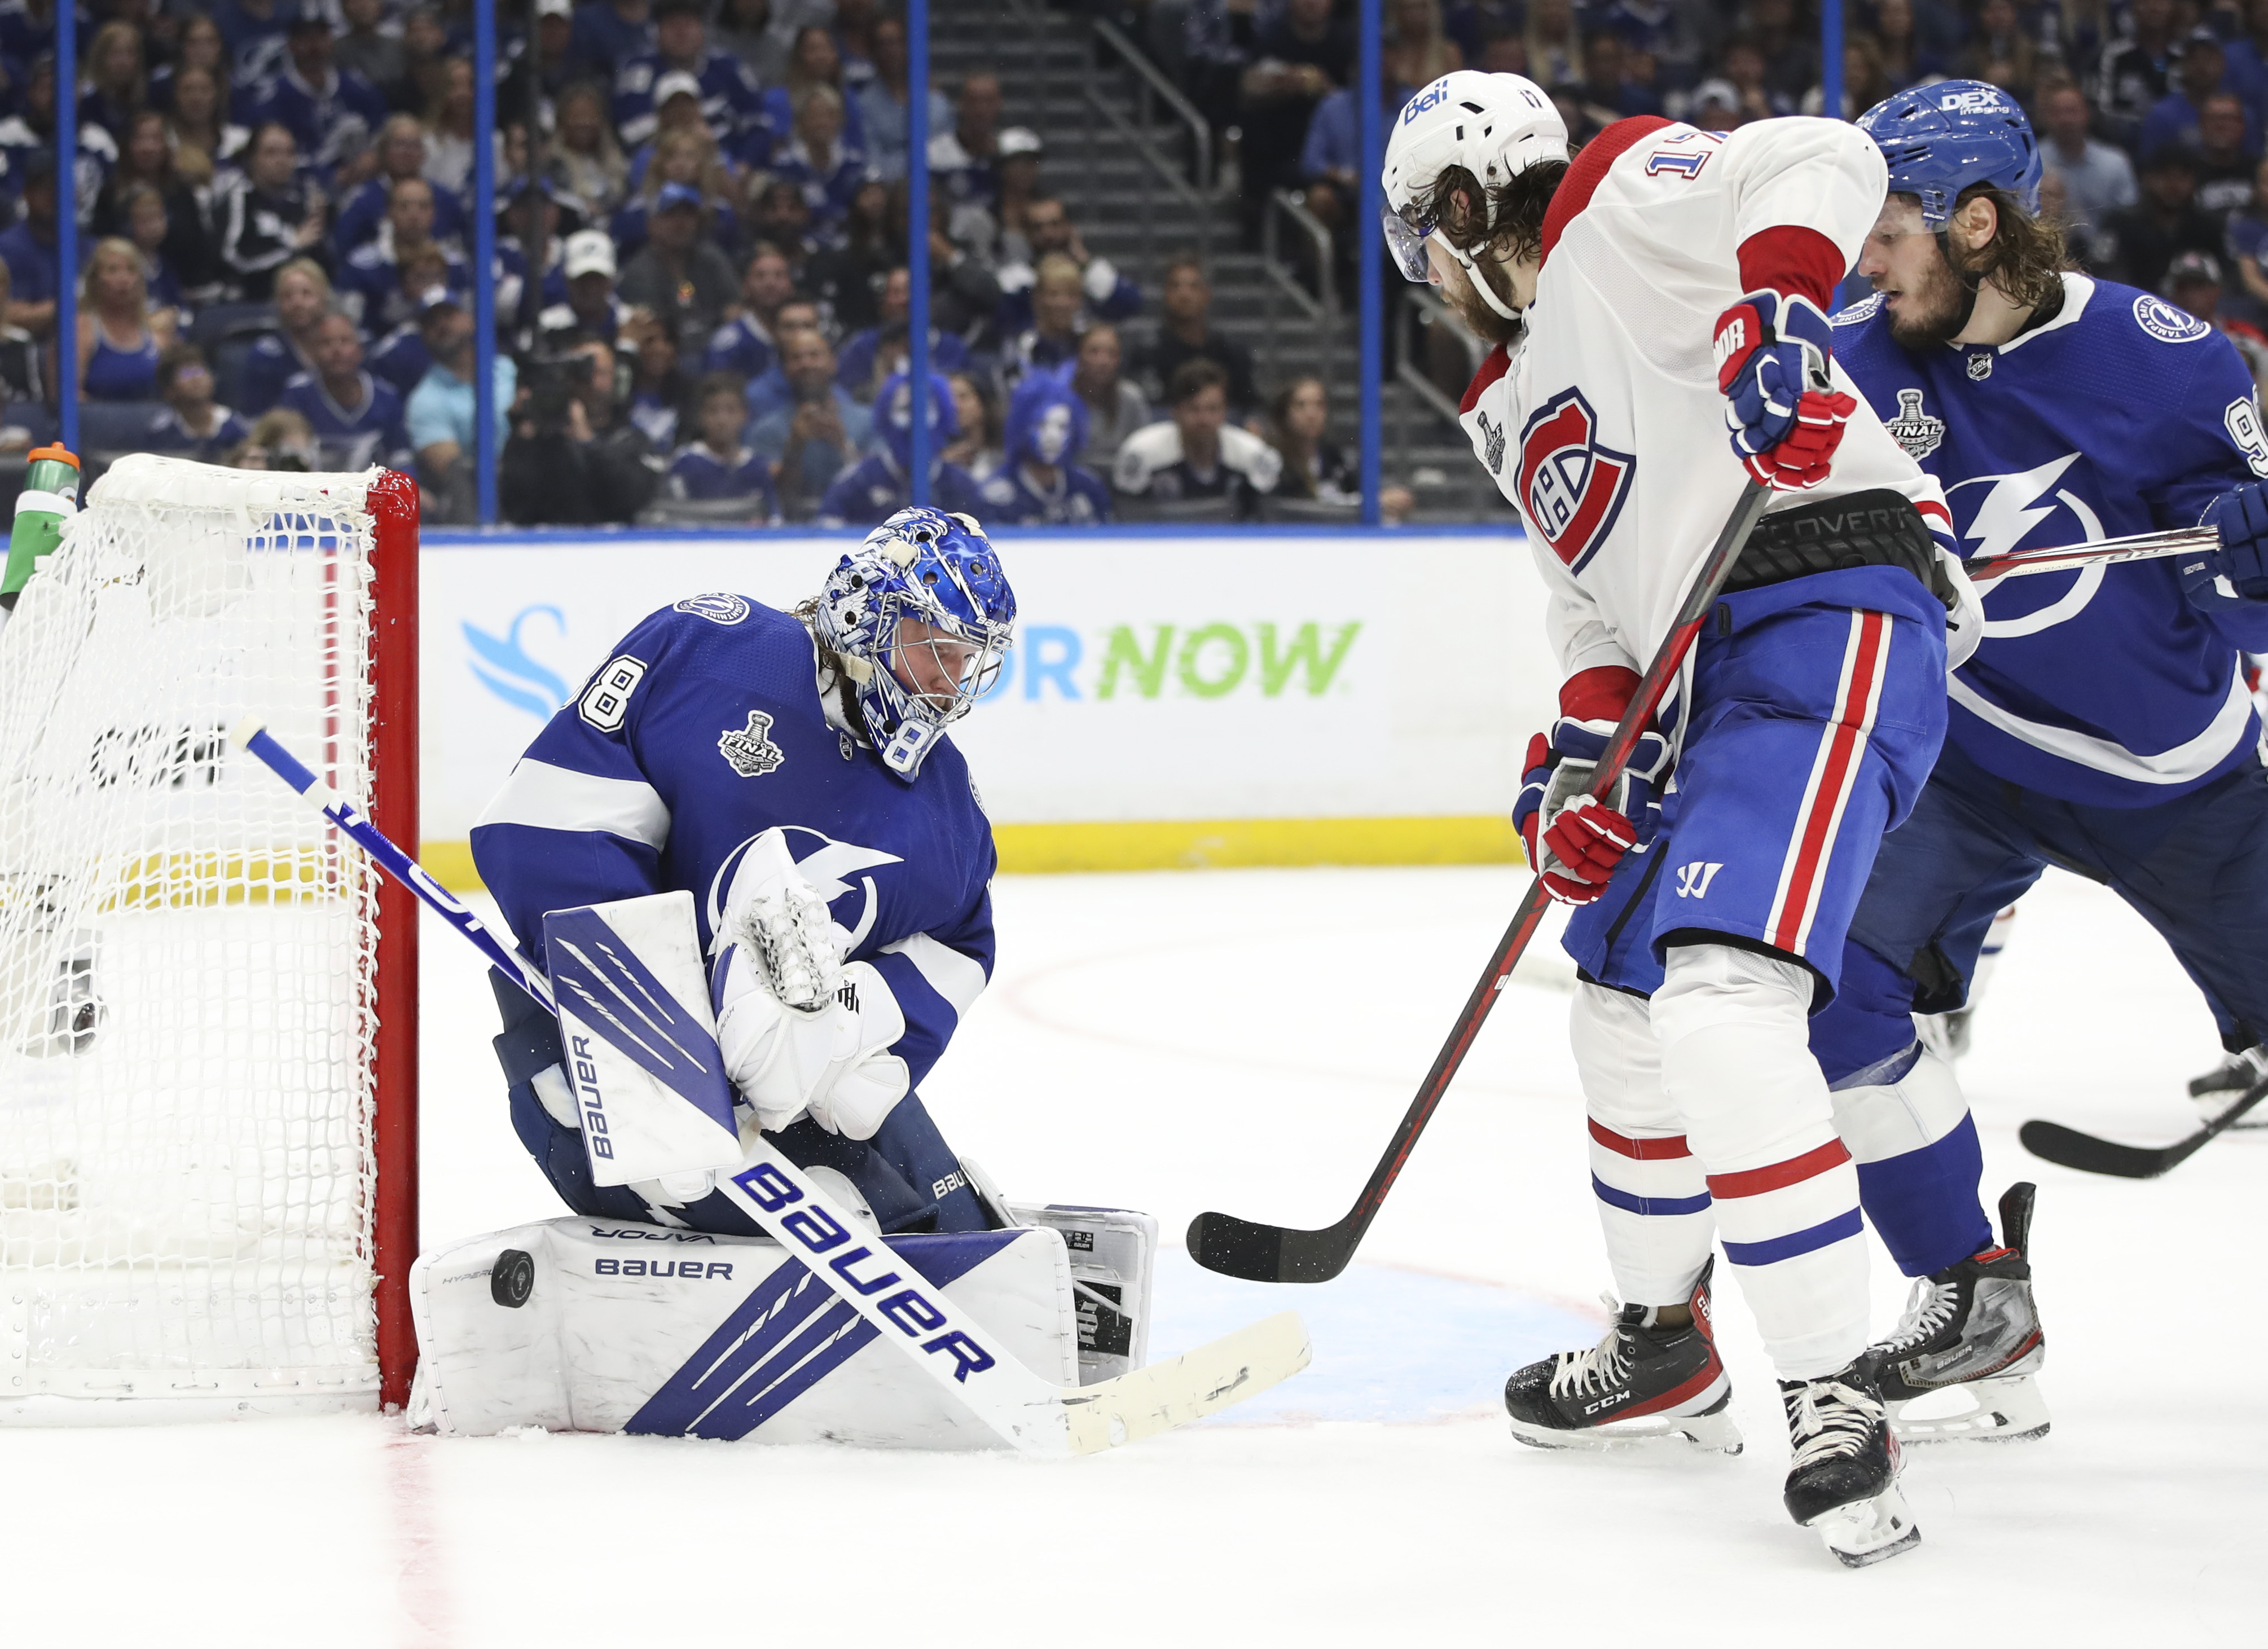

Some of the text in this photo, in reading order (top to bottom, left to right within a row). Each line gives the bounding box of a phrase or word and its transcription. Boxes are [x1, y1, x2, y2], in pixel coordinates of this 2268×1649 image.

[1404, 80, 1448, 125] Bell
[1518, 89, 1544, 108] 17
[1941, 91, 2001, 112] DEX
[1959, 105, 2010, 116] imaging
[1887, 425, 1940, 437] FINAL
[2223, 384, 2268, 480] 9
[725, 736, 776, 762] FINAL
[735, 733, 761, 746] STANLEY
[572, 1035, 614, 1160] BAUER
[589, 1224, 715, 1245] VAPOR
[595, 1259, 733, 1281] BAUER
[730, 1162, 996, 1385] BAUER
[1937, 1344, 1972, 1370] BAUER
[1584, 1389, 1630, 1415] CCM
